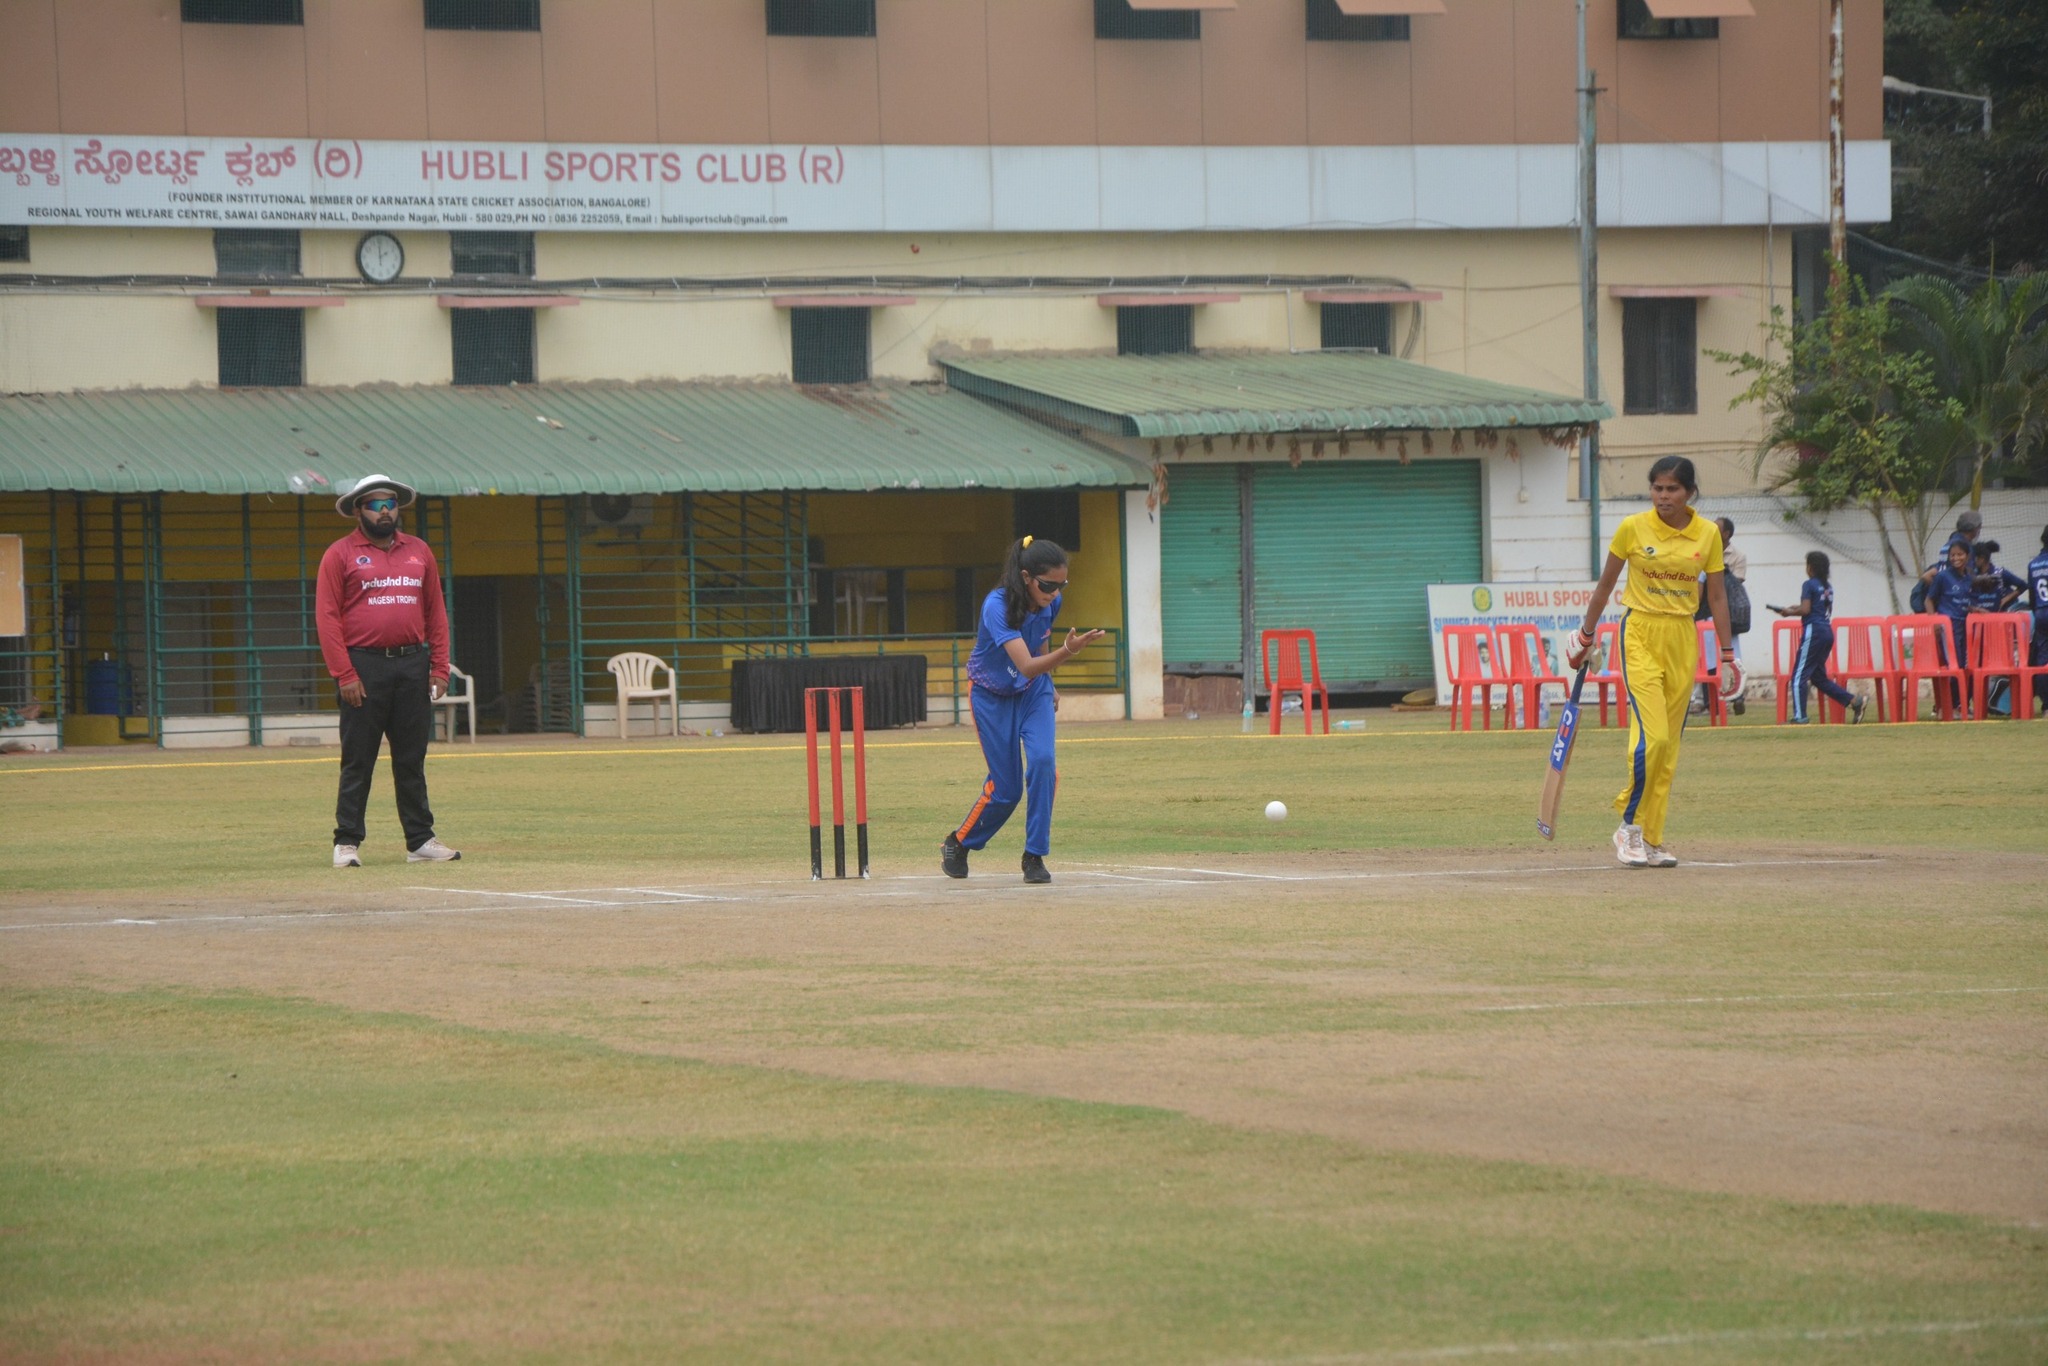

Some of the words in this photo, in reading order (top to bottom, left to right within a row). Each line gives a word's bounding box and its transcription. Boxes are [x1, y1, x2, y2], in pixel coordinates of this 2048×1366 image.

[421, 150, 528, 181] HUBLI
[544, 151, 682, 182] SPORTS
[697, 153, 787, 183] CLUB
[799, 146, 845, 184] (R)
[167, 192, 223, 203] (FOUNDER
[225, 193, 307, 205] INSTITUTIONAL
[309, 194, 353, 206] MEMBER
[355, 195, 369, 206] OF
[371, 195, 435, 207] KARNATAKA
[437, 196, 469, 207] STATE
[471, 196, 515, 207] CRICKET
[517, 197, 588, 209] ASSOCIATION,
[588, 197, 651, 209] BANGALORE)
[27, 206, 83, 218] REGIONAL
[84, 207, 122, 218] YOUTH
[125, 208, 174, 219] WELFARE
[176, 208, 222, 221] CENTRE,
[224, 209, 258, 220] SAWAI
[260, 210, 318, 222] GANDHARV
[319, 211, 349, 223] HALL,
[351, 211, 406, 225] Deshpande
[408, 212, 440, 225] Nagar,
[442, 212, 468, 223] Hubli
[475, 213, 494, 223] 580
[531, 213, 546, 223] NO
[625, 214, 652, 224] Email
[367, 595, 396, 606] NAGESH
[1504, 590, 1549, 608] HUBLI
[1552, 590, 1610, 607] SPOR
[1557, 614, 1582, 631] CAMP
